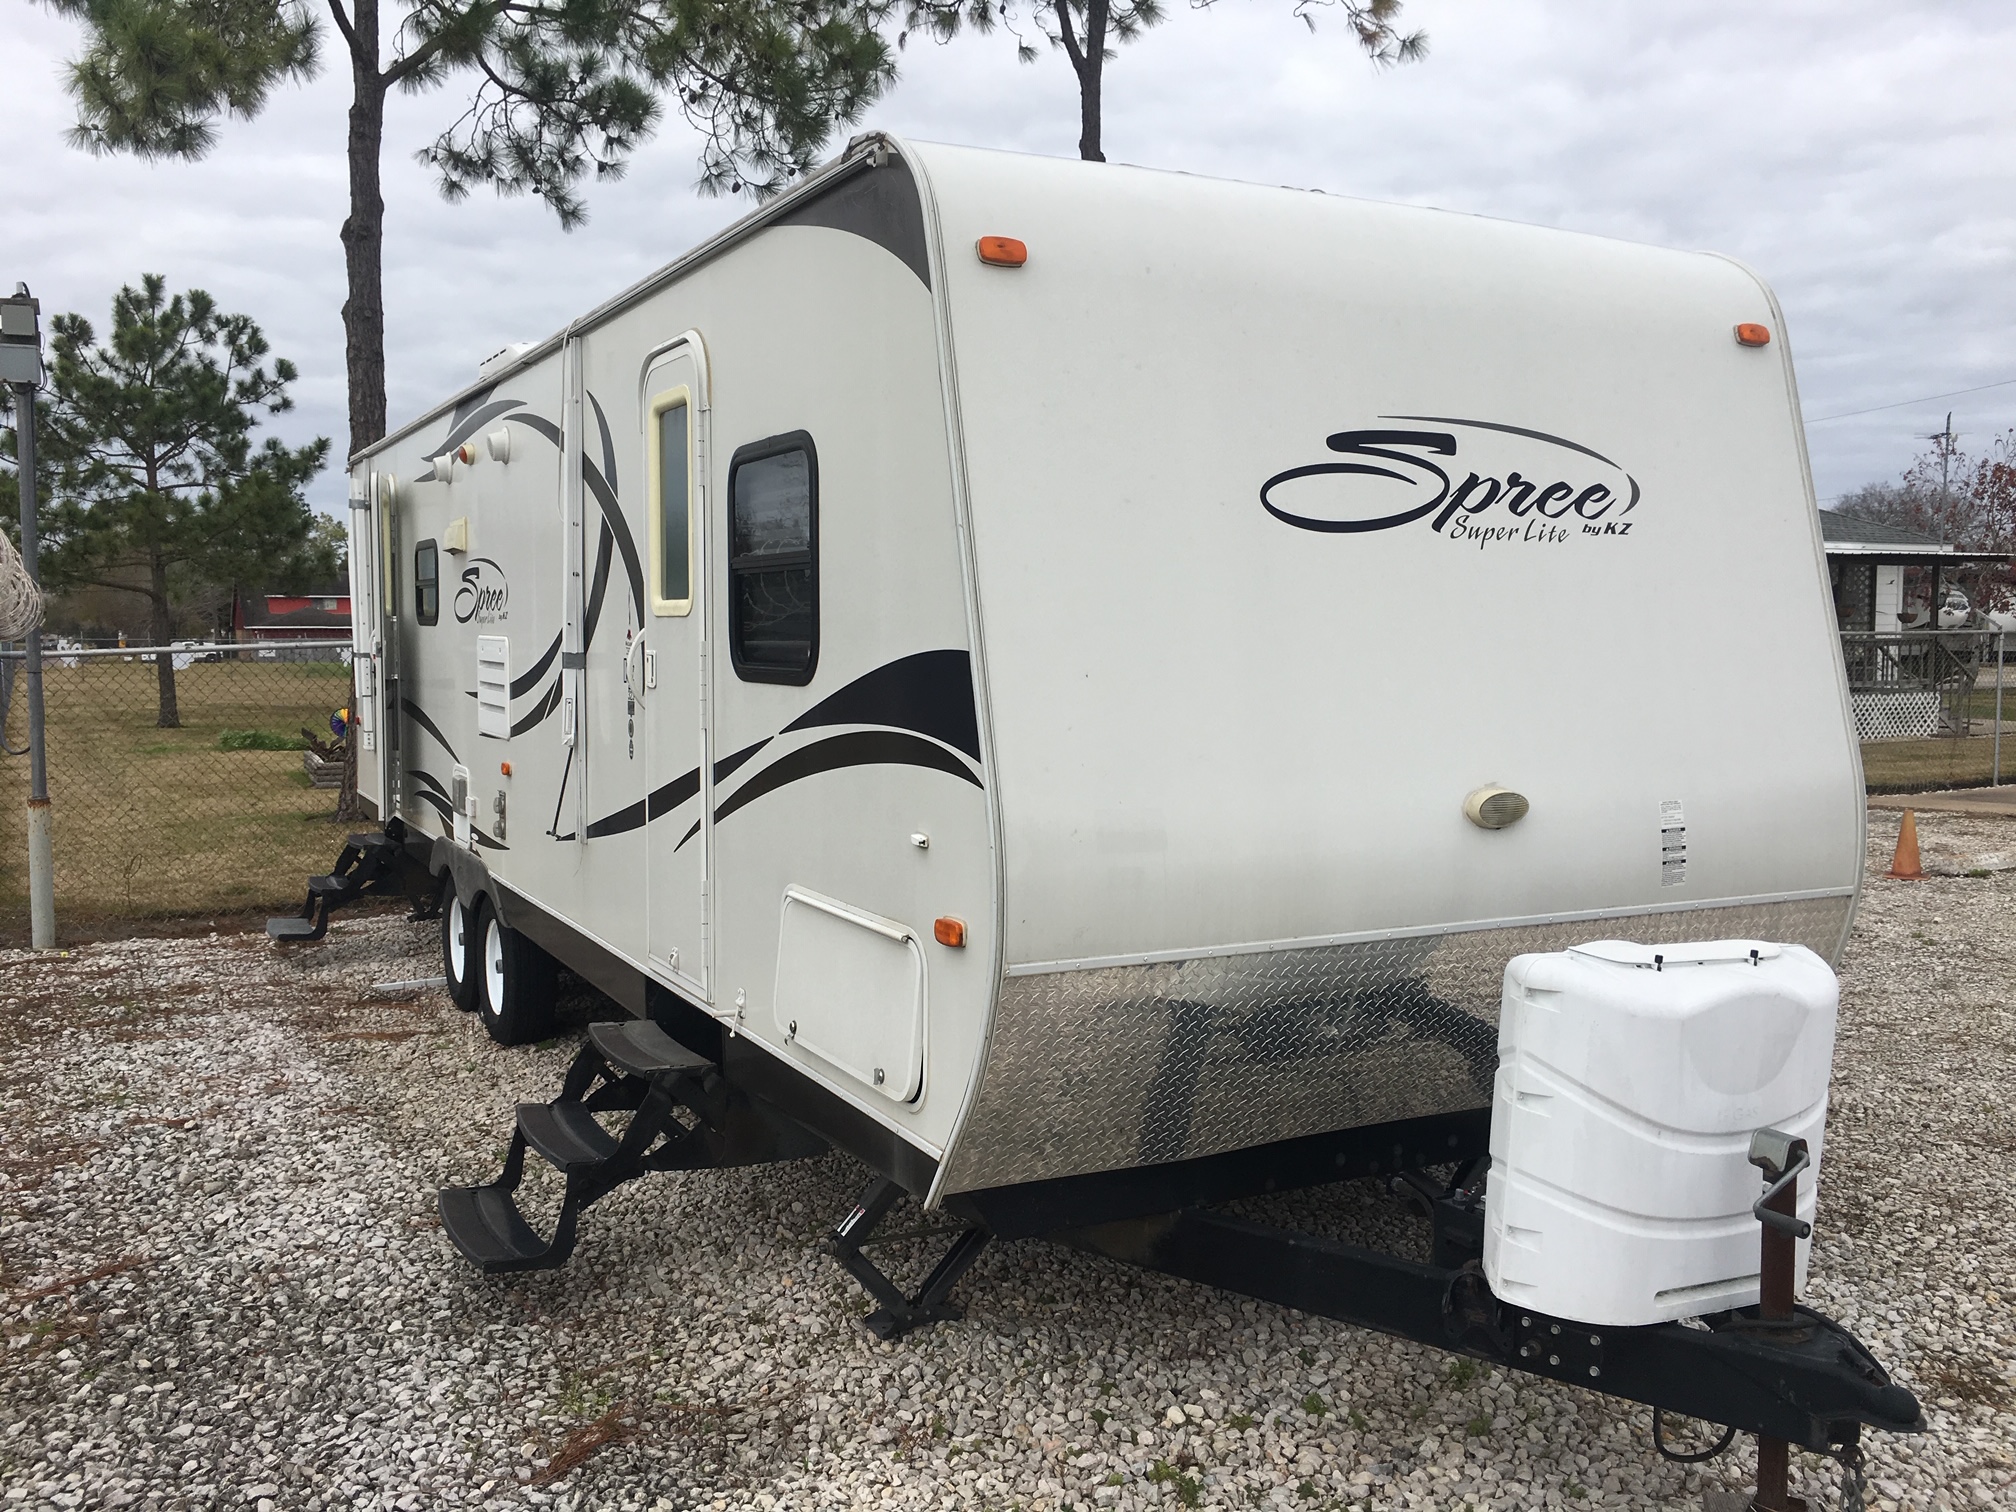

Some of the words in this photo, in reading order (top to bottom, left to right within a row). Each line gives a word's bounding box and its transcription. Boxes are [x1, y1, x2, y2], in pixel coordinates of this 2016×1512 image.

[1260, 430, 1617, 533] Spree
[1450, 514, 1520, 550] Super
[1524, 518, 1570, 543] Lite
[1582, 523, 1602, 536] by
[1603, 522, 1633, 536] KZ
[454, 566, 503, 623] Spree
